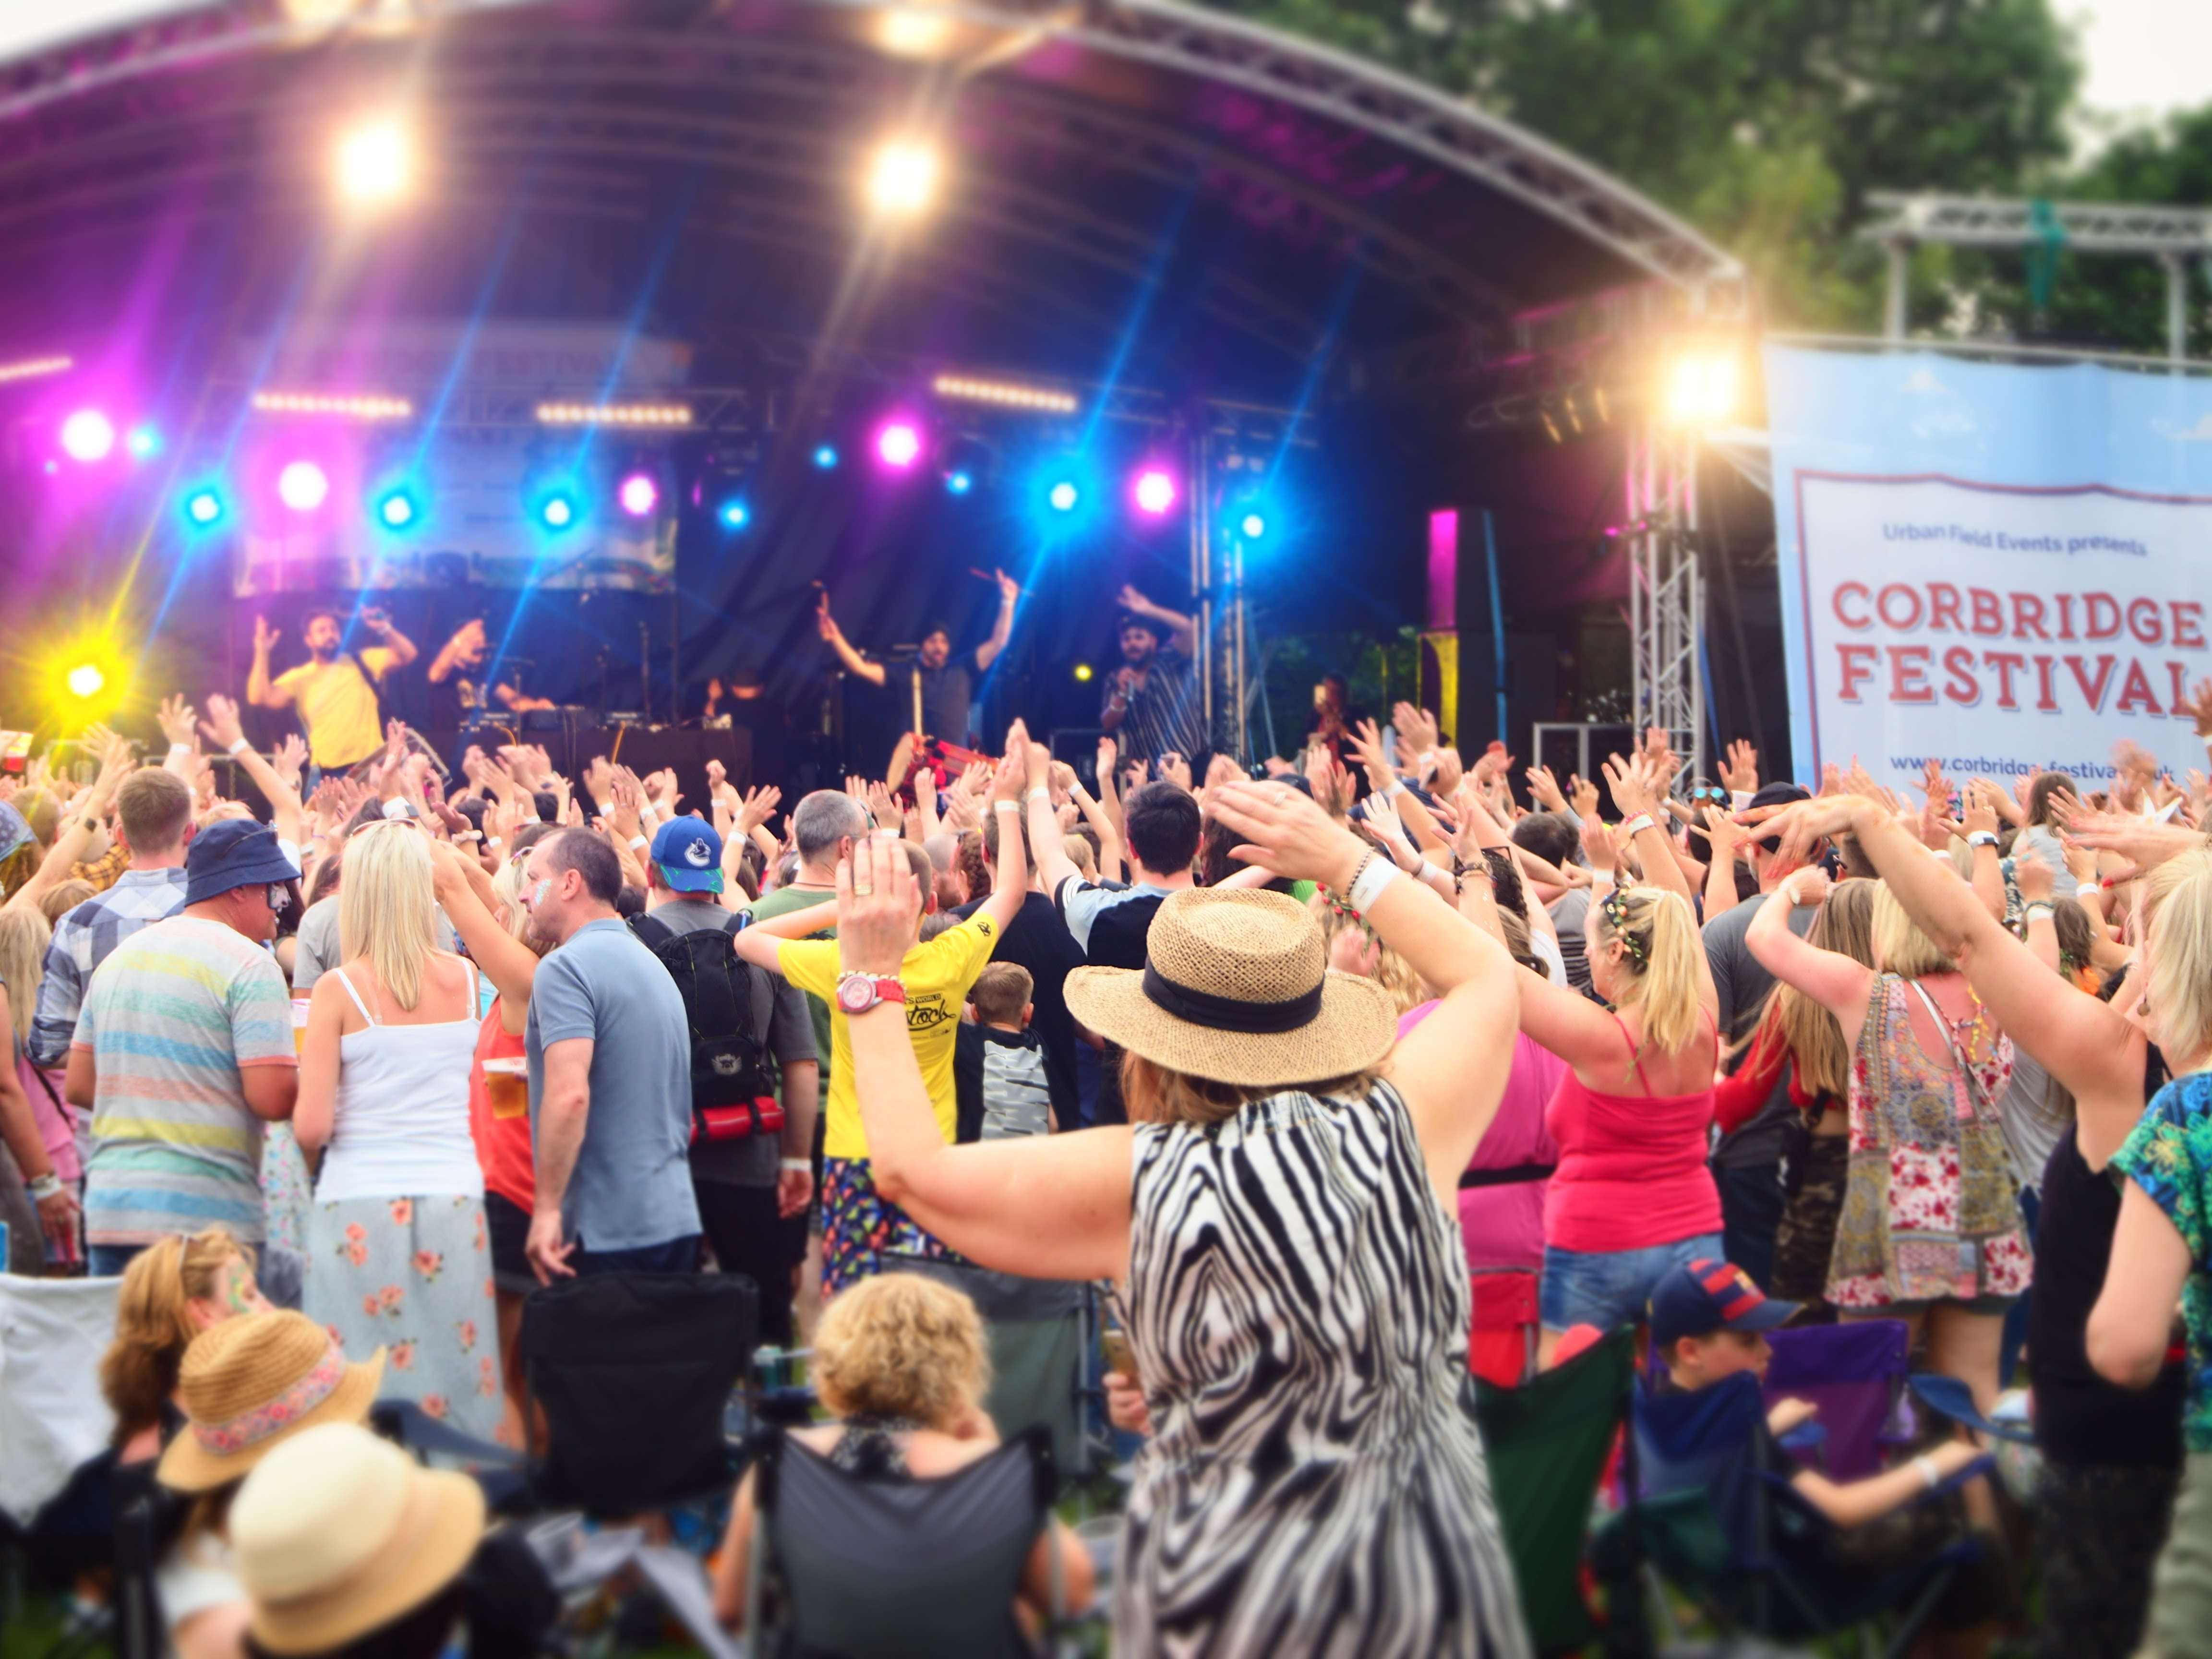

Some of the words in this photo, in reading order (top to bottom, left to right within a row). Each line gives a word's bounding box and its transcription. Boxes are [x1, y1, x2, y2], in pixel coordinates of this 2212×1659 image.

[1883, 523, 1945, 541] Urban
[1949, 524, 1993, 548] Field
[1996, 532, 2063, 552] Events
[2068, 535, 2147, 556] presents
[1832, 581, 2208, 650] CORBRIDGE
[1834, 643, 2198, 720] FESTIVAL
[916, 994, 941, 1003] WORLD
